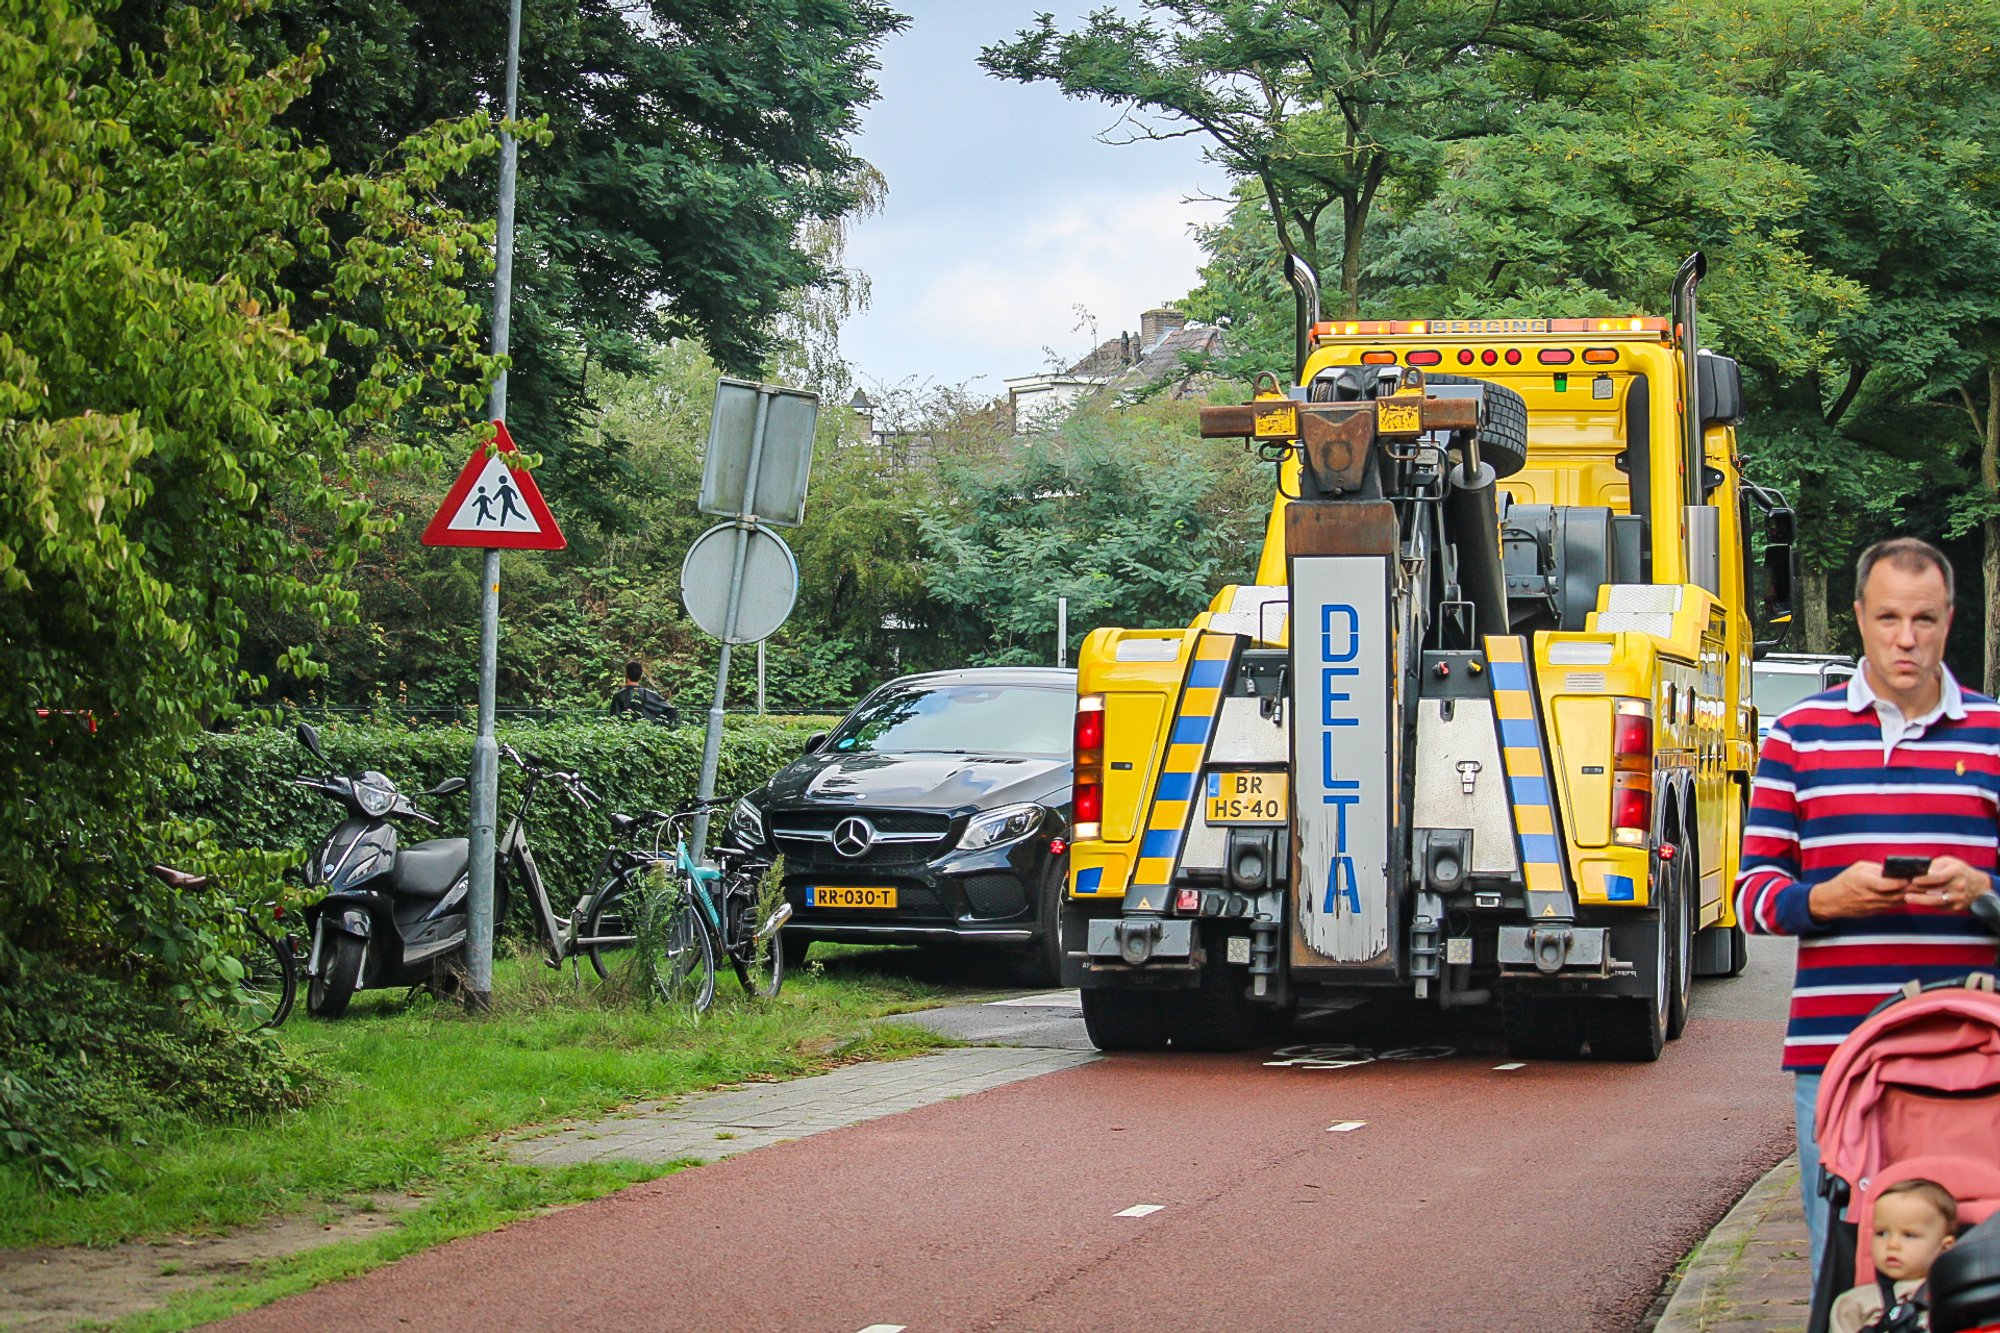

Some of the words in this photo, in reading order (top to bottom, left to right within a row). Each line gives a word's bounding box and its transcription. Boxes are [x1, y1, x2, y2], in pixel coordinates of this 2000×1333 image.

[1433, 320, 1545, 334] BERGING
[1321, 604, 1361, 914] DELTA
[1235, 776, 1263, 794] BR
[1214, 800, 1279, 818] HS-40
[818, 889, 890, 905] RR-030-T
